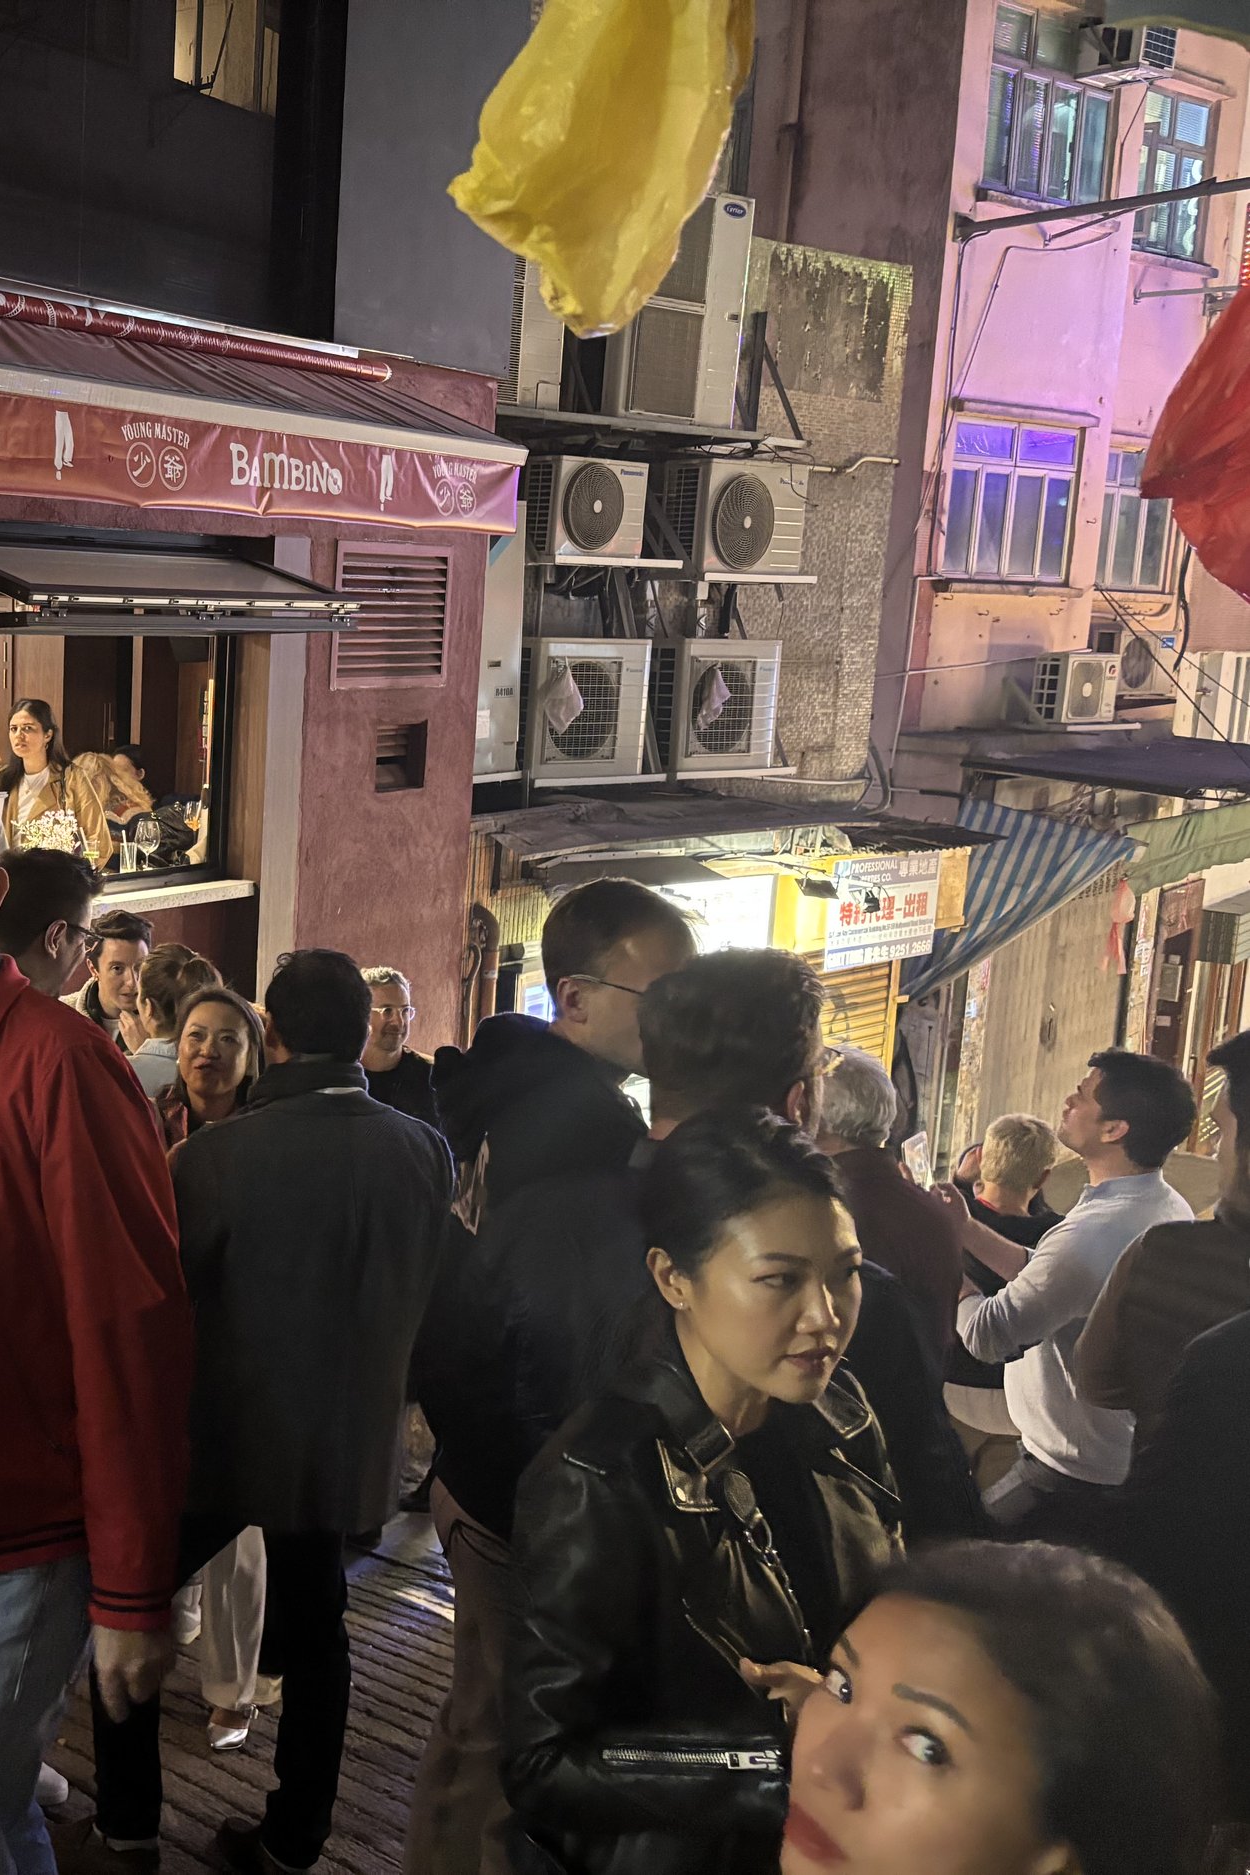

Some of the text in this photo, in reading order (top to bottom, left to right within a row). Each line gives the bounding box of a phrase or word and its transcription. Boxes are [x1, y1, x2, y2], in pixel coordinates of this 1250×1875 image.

[121, 421, 190, 450] YOUNG MASTER
[229, 442, 343, 495] BAMBINO
[851, 860, 898, 874] PROFESSIONAL
